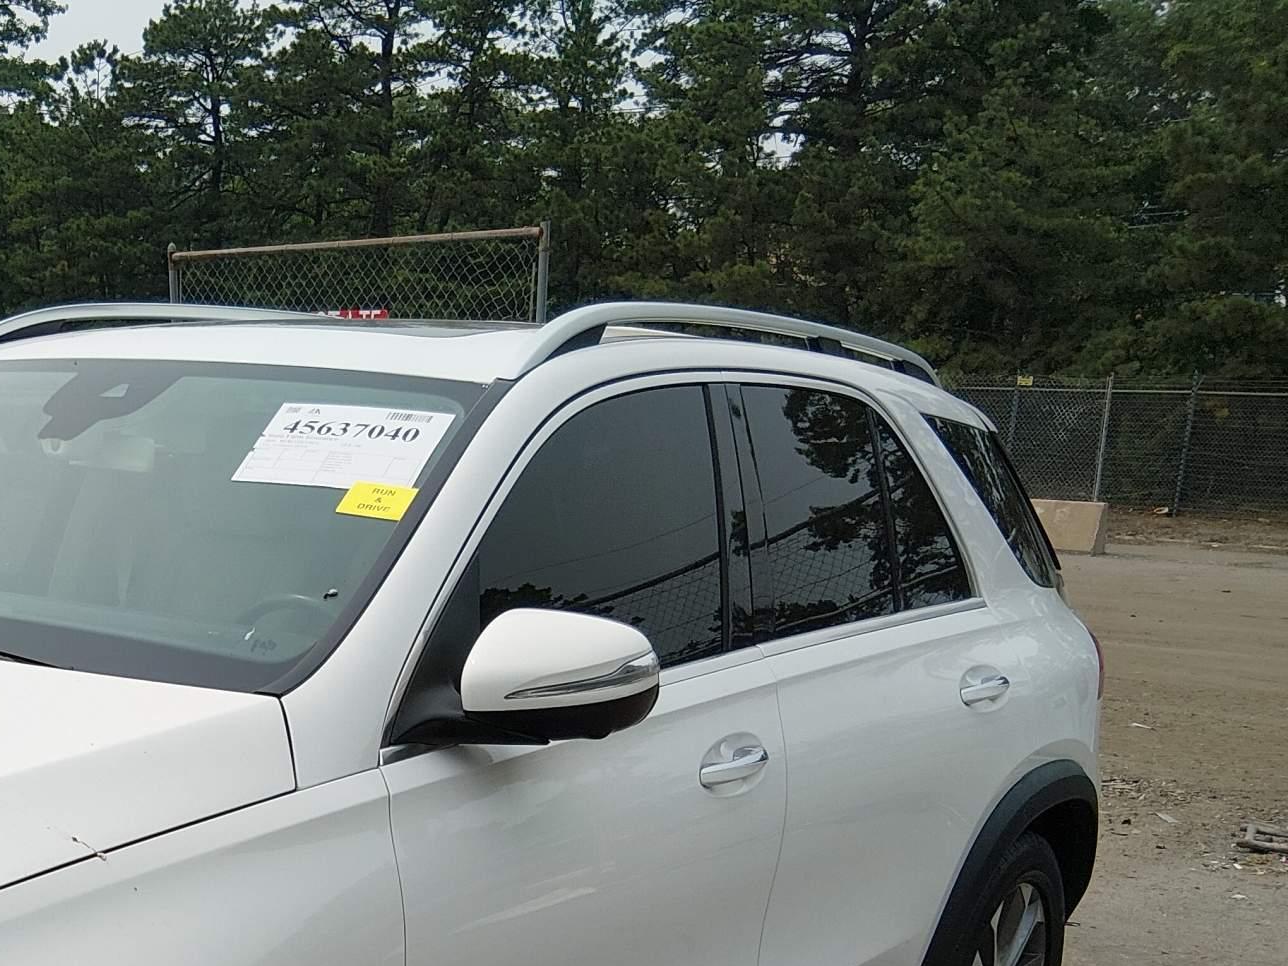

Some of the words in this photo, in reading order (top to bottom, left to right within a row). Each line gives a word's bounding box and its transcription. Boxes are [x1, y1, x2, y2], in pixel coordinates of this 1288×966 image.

[283, 420, 420, 442] 45637040
[372, 487, 397, 496] RUN
[357, 503, 391, 512] DRIVE
